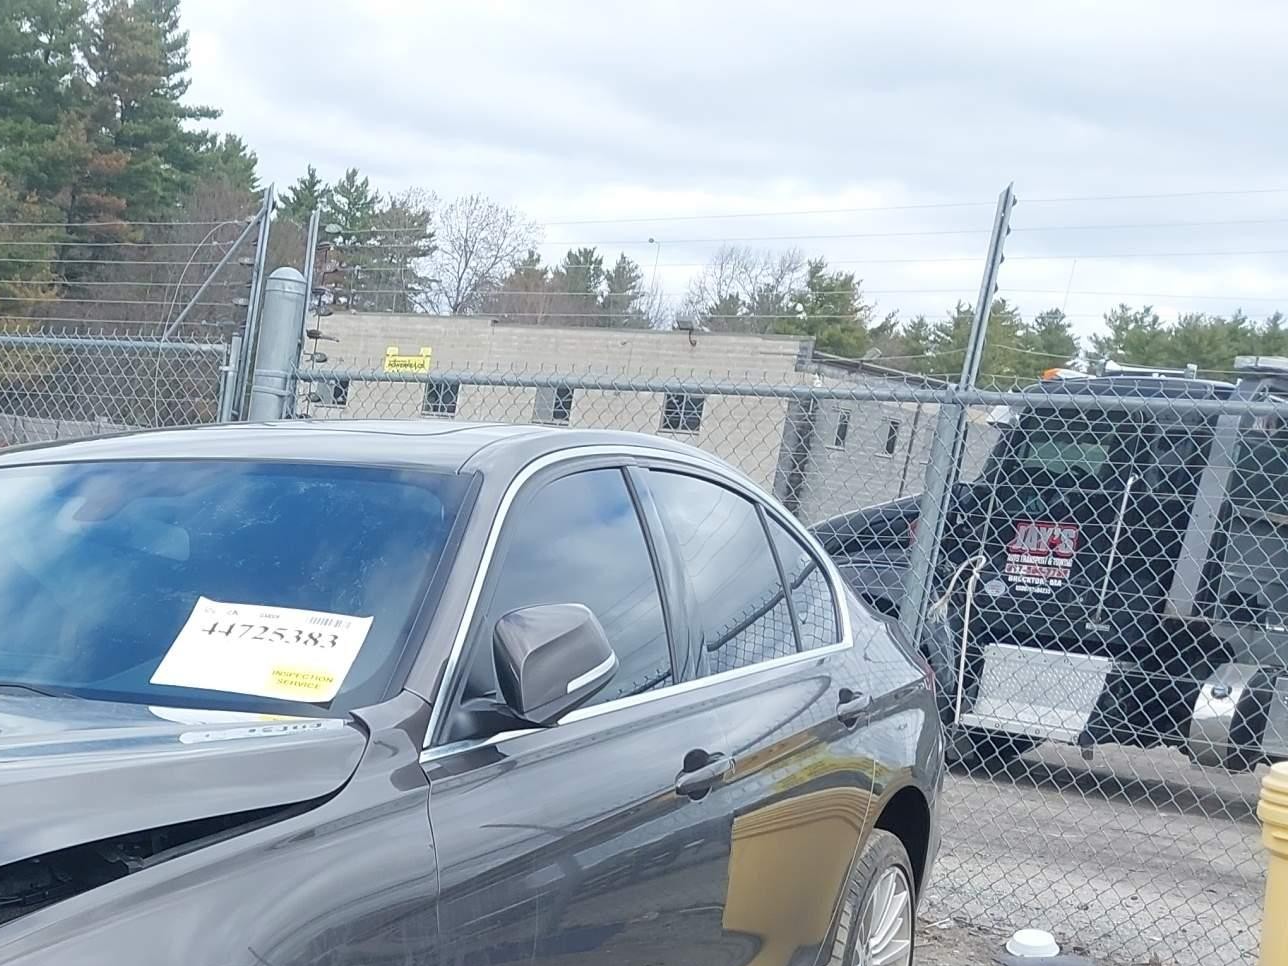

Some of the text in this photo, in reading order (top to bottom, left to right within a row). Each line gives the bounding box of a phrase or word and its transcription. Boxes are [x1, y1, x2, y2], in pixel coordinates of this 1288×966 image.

[1011, 525, 1076, 554] JAY'S
[202, 621, 339, 648] 44725383
[271, 670, 334, 683] INSPECTION
[277, 678, 321, 690] SERVICE
